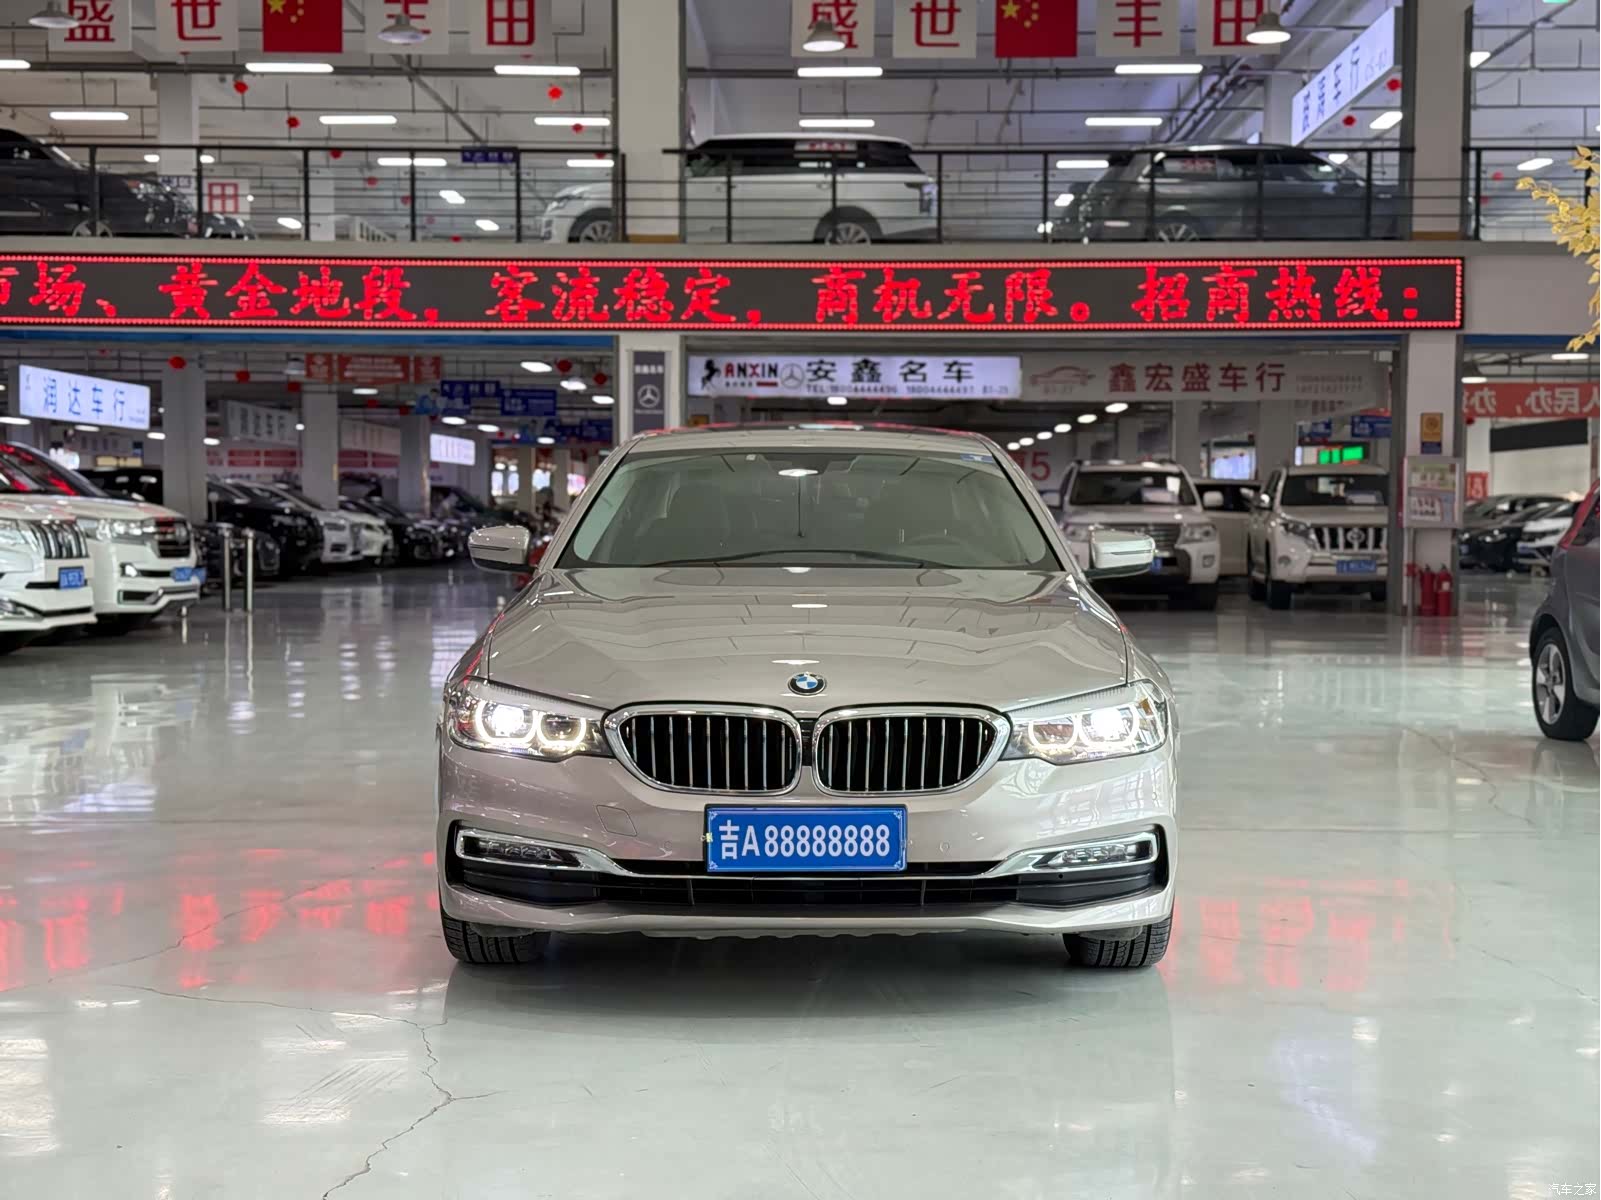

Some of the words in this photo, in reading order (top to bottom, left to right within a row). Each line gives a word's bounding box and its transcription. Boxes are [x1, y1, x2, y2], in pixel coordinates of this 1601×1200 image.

[171, 0, 221, 40] 世
[486, 0, 535, 46] 田
[910, 0, 961, 47] 世
[1113, 0, 1162, 48] 丰
[1213, 0, 1264, 46] 田
[725, 362, 778, 378] ANXIN
[805, 358, 974, 383] 安鑫名车
[1108, 362, 1287, 393] 鑫宏盛车行
[43, 376, 125, 422] 润达车行
[718, 819, 890, 860] 吉A88888888
